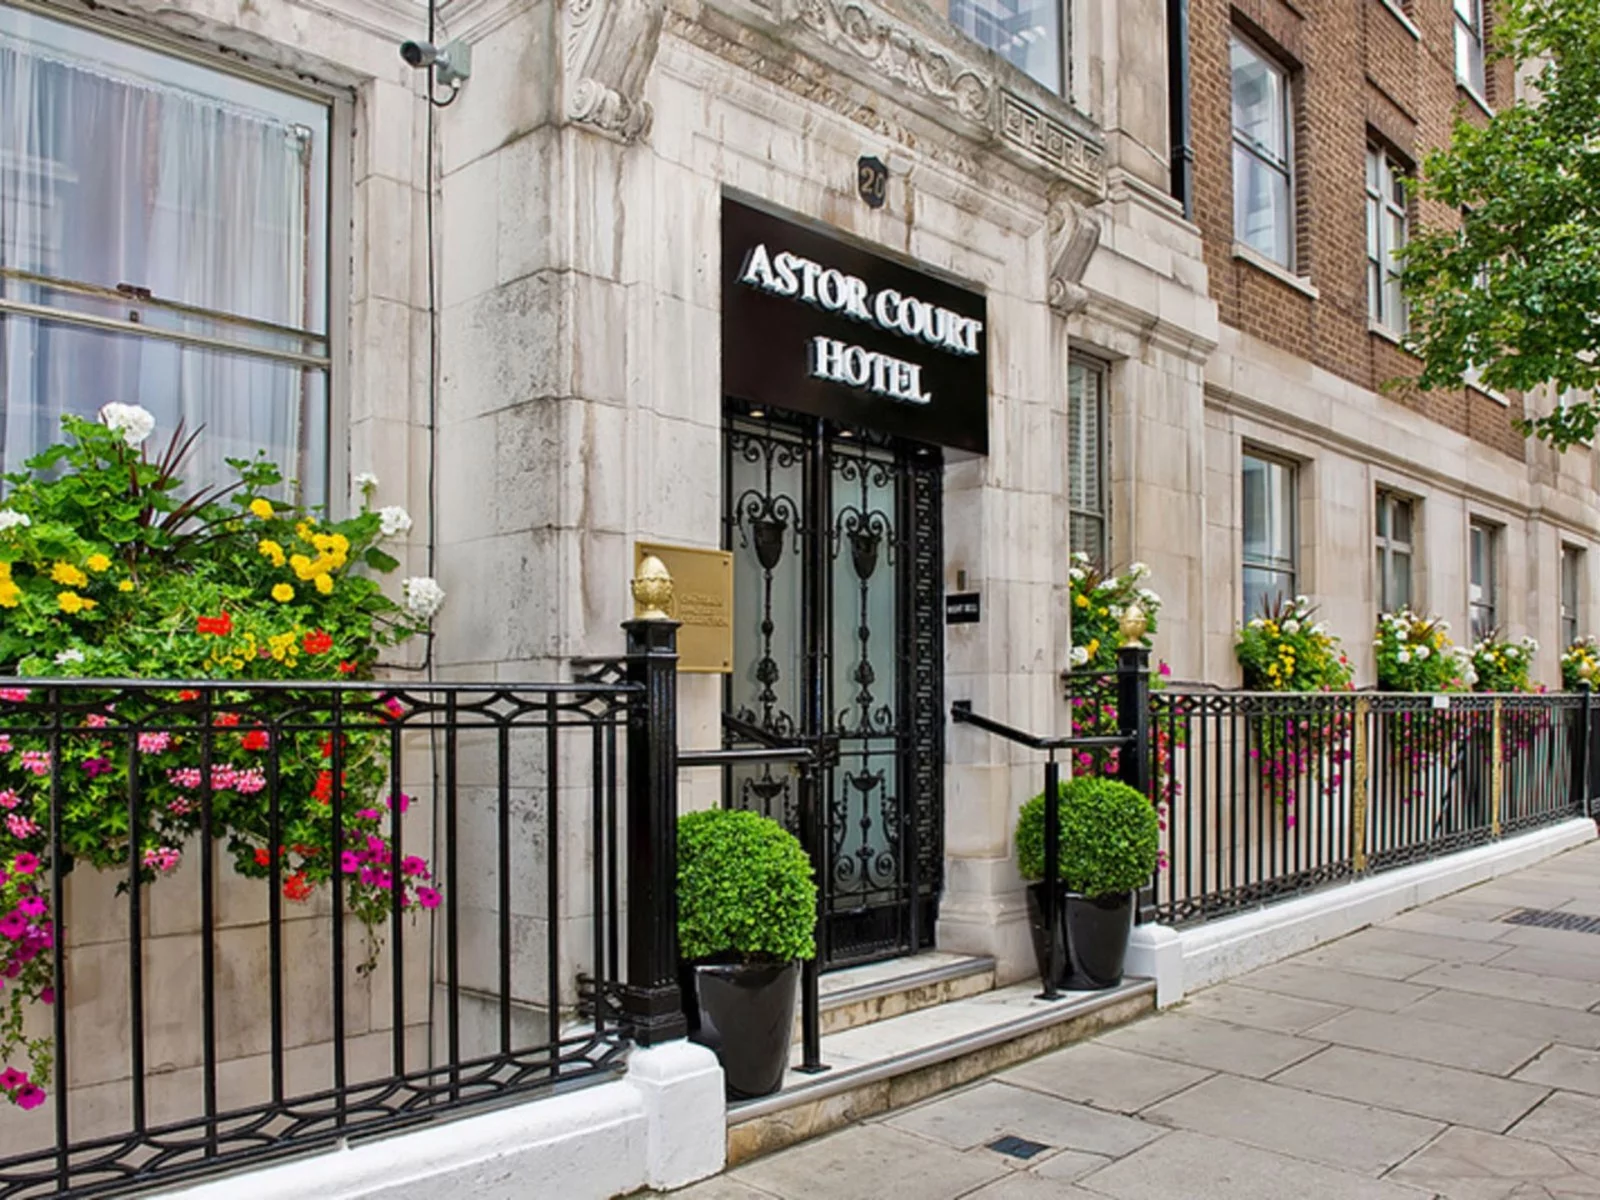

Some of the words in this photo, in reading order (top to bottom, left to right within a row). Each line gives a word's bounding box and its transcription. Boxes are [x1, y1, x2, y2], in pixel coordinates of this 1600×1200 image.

[860, 167, 885, 198] 20
[740, 243, 873, 321] ASTOR
[875, 288, 982, 354] COURT
[811, 335, 932, 404] HOTEL
